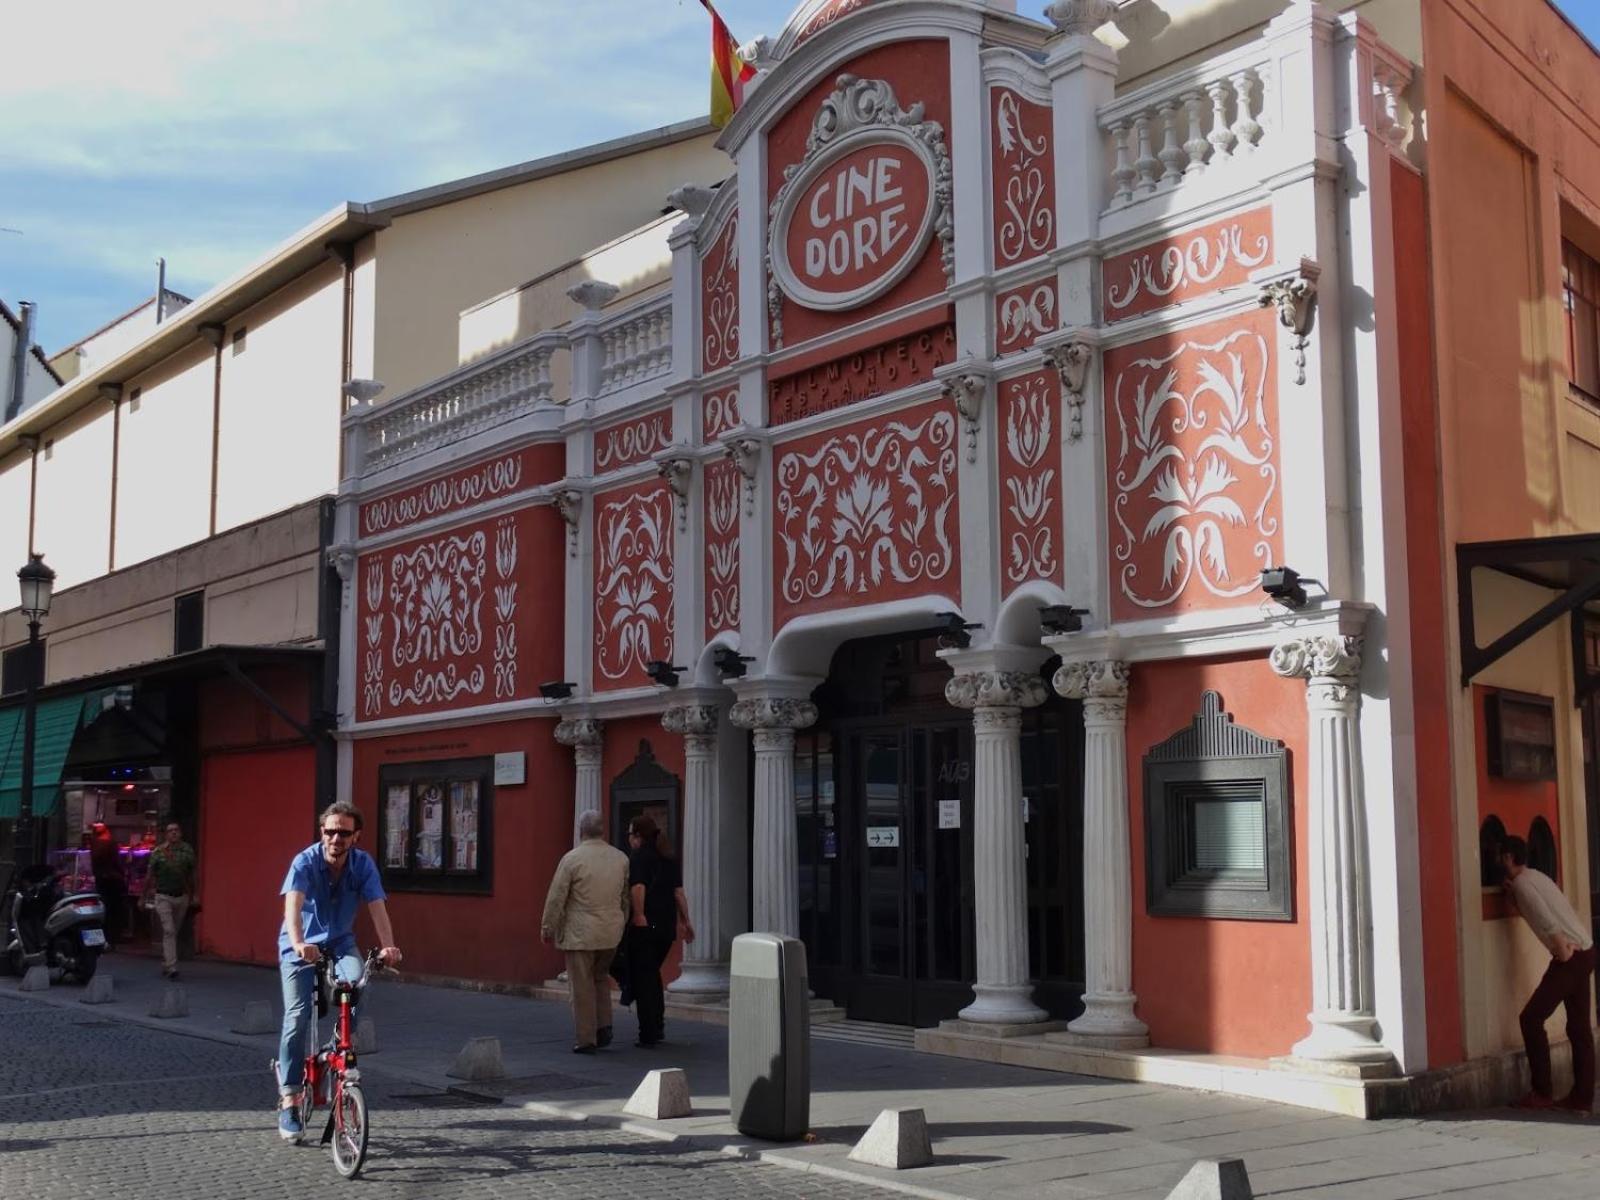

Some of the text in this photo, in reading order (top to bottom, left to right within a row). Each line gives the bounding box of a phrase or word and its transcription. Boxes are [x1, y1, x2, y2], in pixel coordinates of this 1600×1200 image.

[810, 157, 903, 228] CINE
[806, 203, 909, 278] DORE
[771, 326, 956, 396] FILMOTECA
[784, 348, 945, 413] ESPAÑOLA
